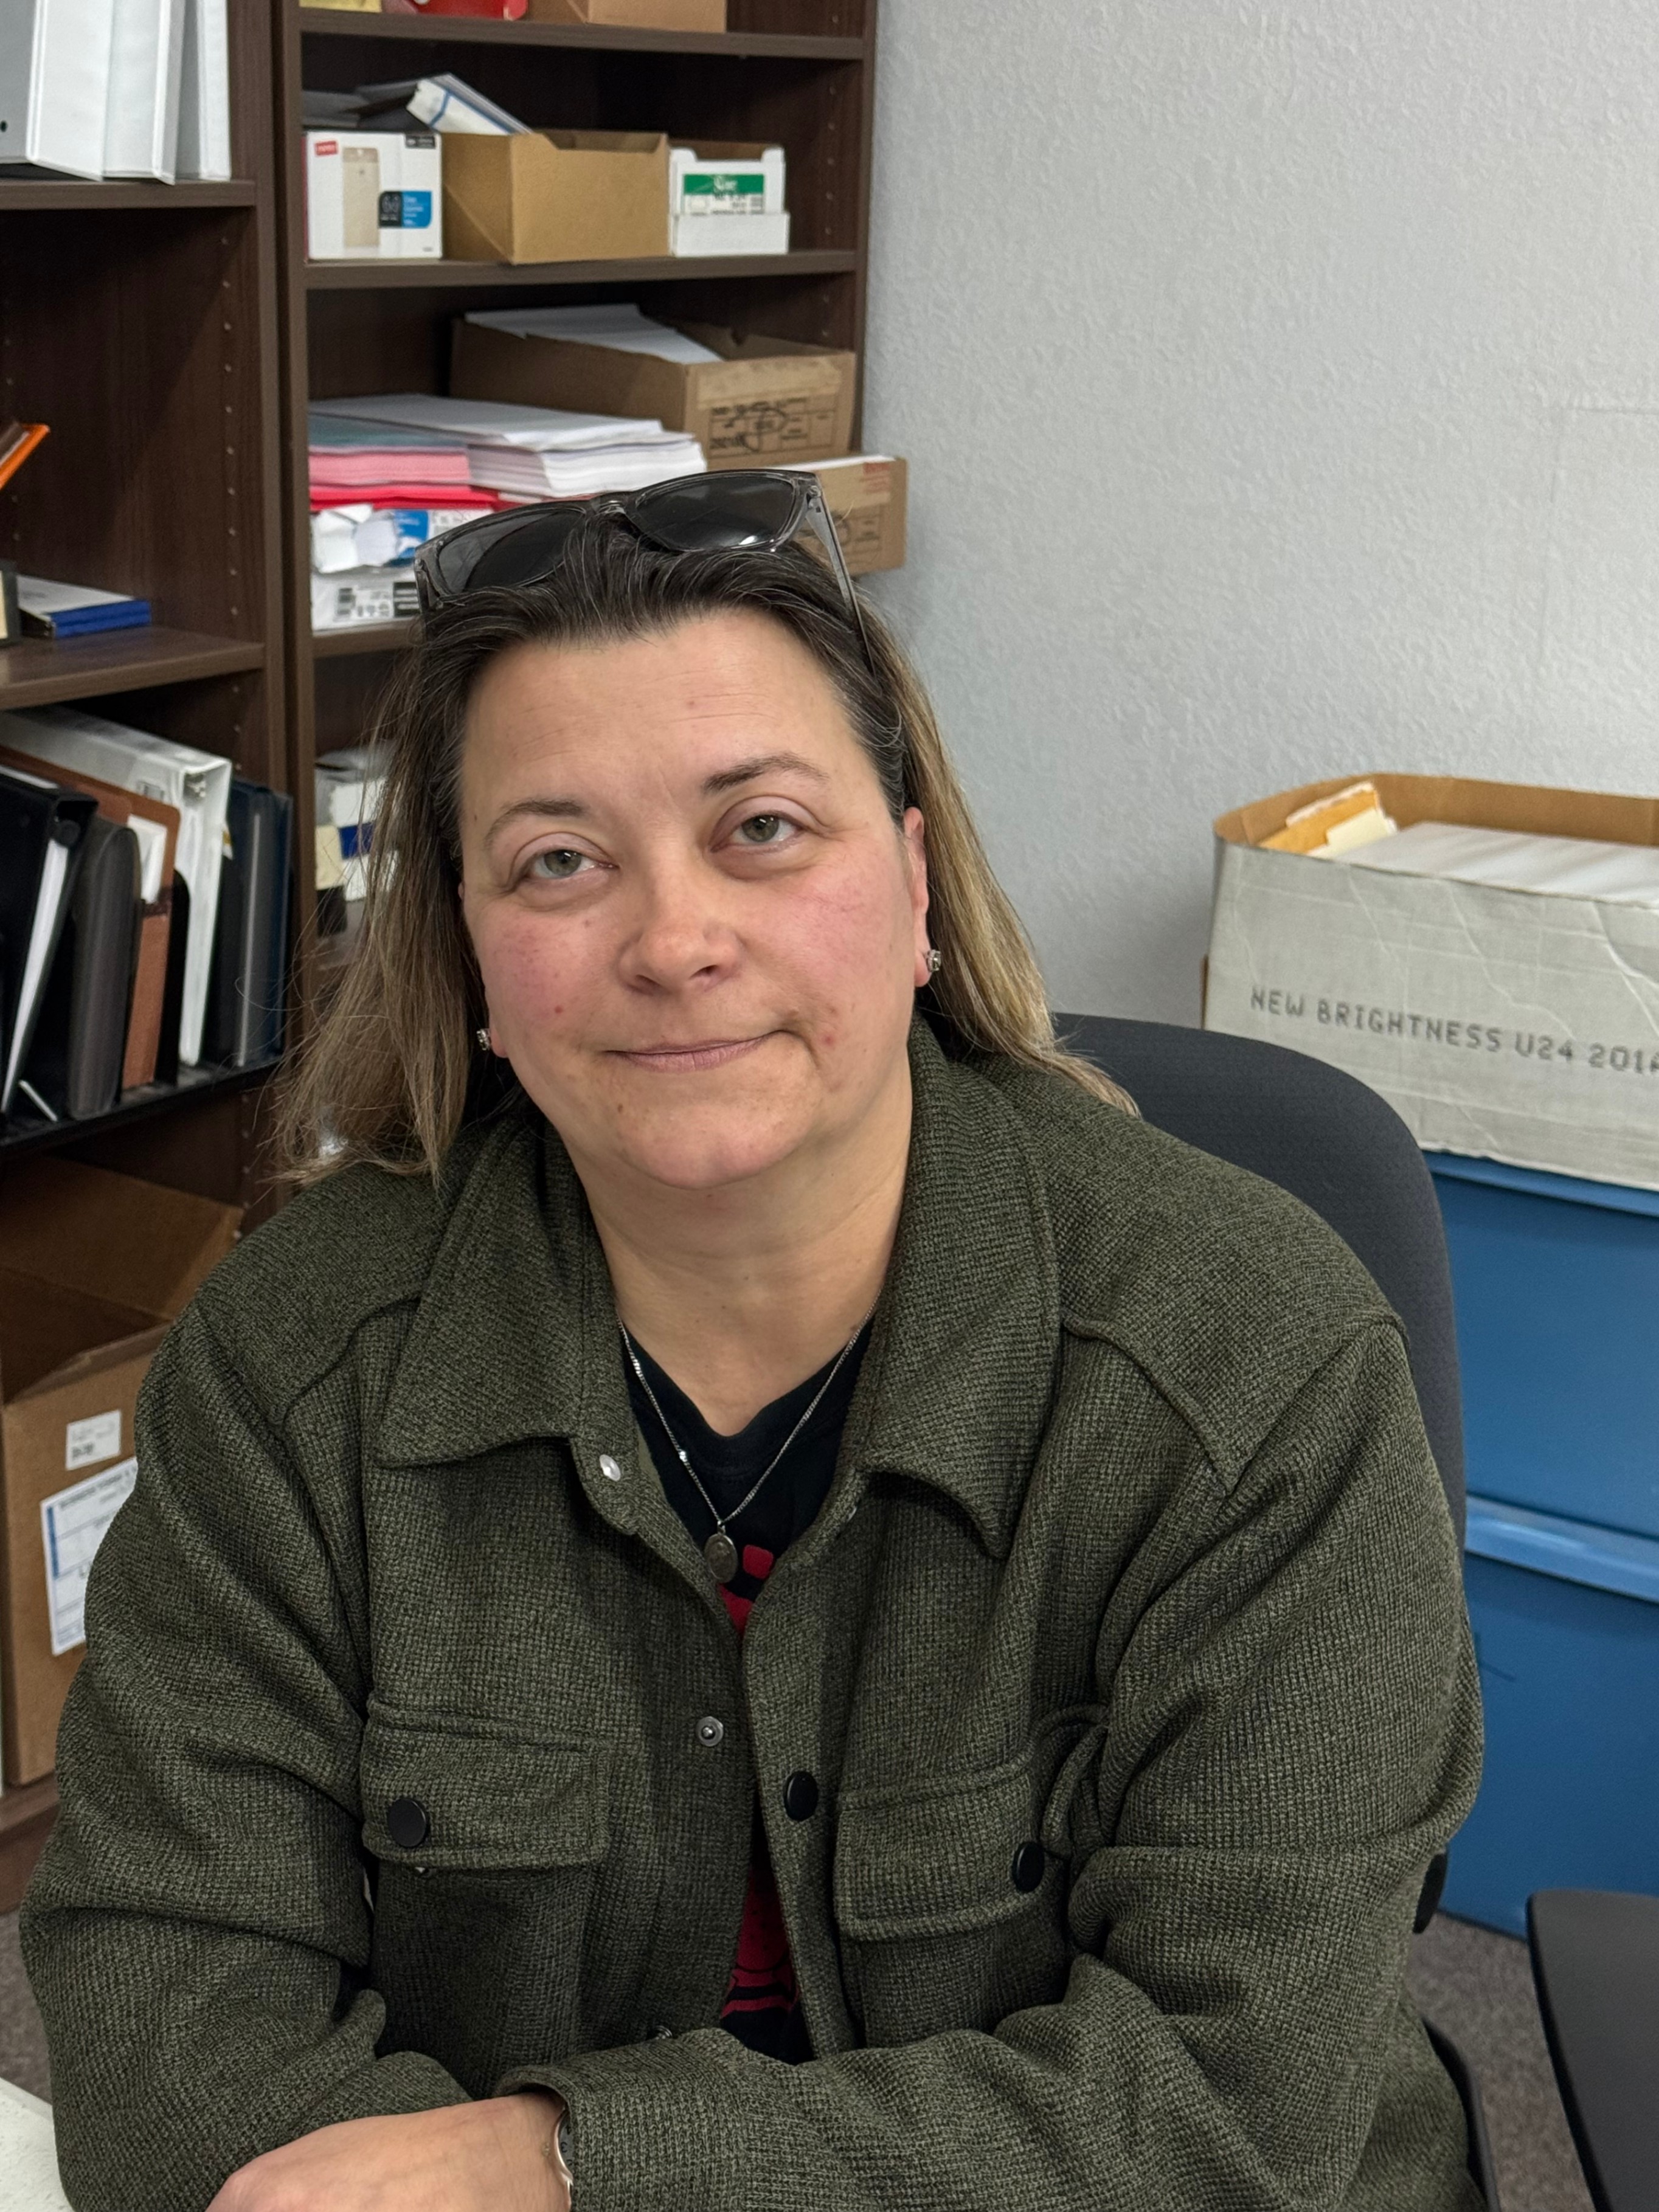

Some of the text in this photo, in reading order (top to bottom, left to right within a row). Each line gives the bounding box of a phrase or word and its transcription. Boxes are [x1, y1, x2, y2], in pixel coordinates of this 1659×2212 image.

[1250, 986, 1304, 1017] NEW
[1317, 998, 1501, 1052] BRIGHTNESS
[1515, 1032, 1573, 1062] U24
